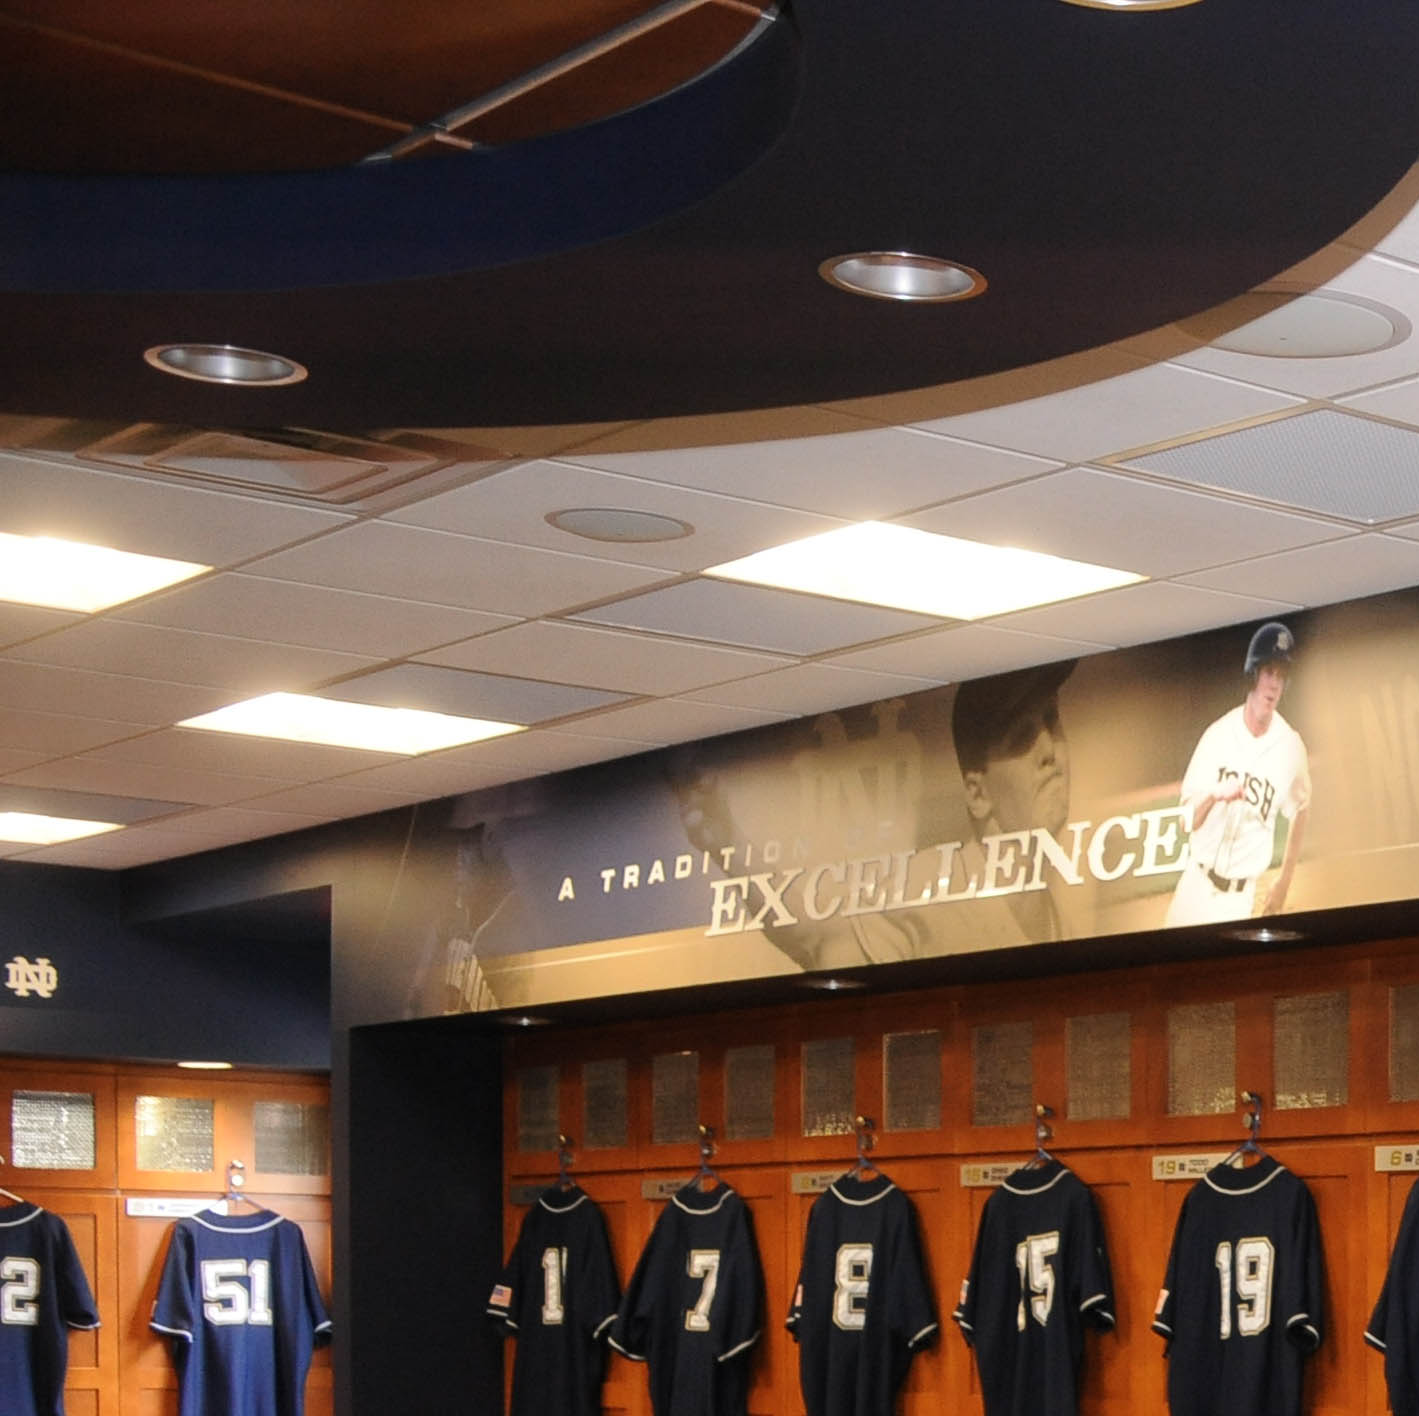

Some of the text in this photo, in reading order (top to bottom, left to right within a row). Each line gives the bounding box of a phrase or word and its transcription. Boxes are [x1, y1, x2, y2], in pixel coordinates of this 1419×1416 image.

[558, 876, 575, 902] A
[703, 803, 1196, 938] EXCELLENCE
[1158, 1160, 1176, 1175] 19
[1390, 1150, 1403, 1167] 6
[200, 1257, 274, 1326] 51
[684, 1248, 721, 1332] 7
[1015, 1229, 1060, 1332] 15
[1215, 1235, 1276, 1340] 19
